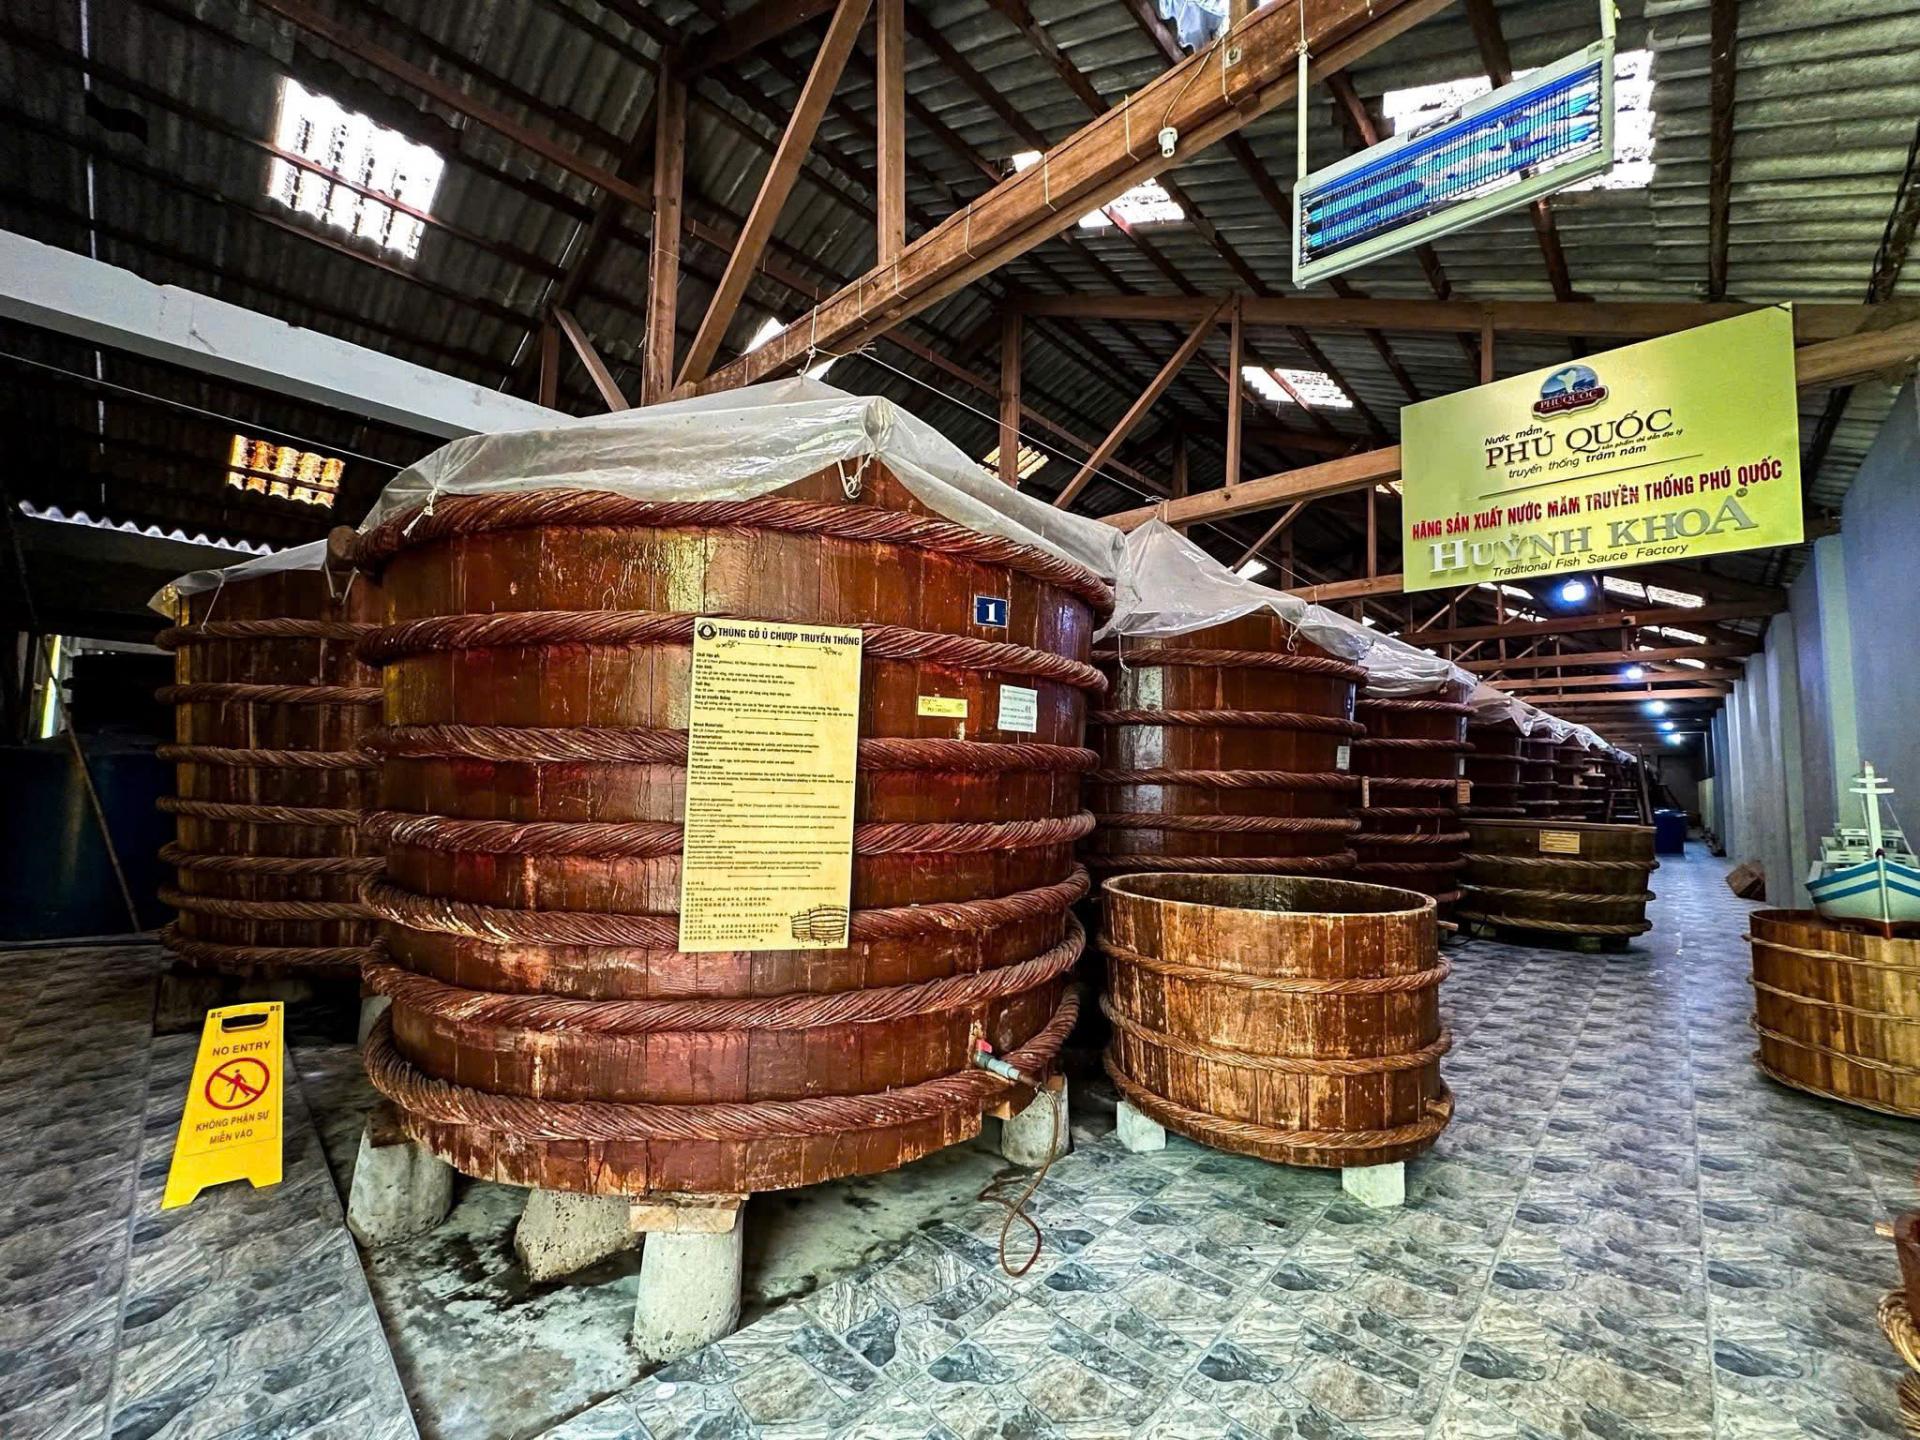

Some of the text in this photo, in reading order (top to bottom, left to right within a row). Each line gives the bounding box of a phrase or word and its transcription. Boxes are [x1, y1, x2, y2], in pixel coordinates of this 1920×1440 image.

[1484, 433, 1510, 446] Nước
[1486, 408, 1673, 470] PHÚ QUỐC
[1548, 456, 1580, 472] thống
[1585, 449, 1615, 463] trăm
[1620, 443, 1647, 457] năm
[1412, 519, 1442, 540] HÃNG
[1446, 512, 1469, 534] SẢN
[1474, 505, 1503, 530] XUẤT
[1508, 501, 1542, 525] NƯỚC
[1645, 473, 1694, 501] THỐNG
[1699, 466, 1731, 492] PHÚ
[1737, 456, 1782, 487] QUỐC
[1607, 495, 1759, 548] KHOA
[1493, 544, 1688, 577] Traditional Fish Sauce Factory
[985, 602, 998, 622] 1
[212, 1040, 271, 1056] NO ENTRY
[195, 1118, 228, 1132] KHÔNG
